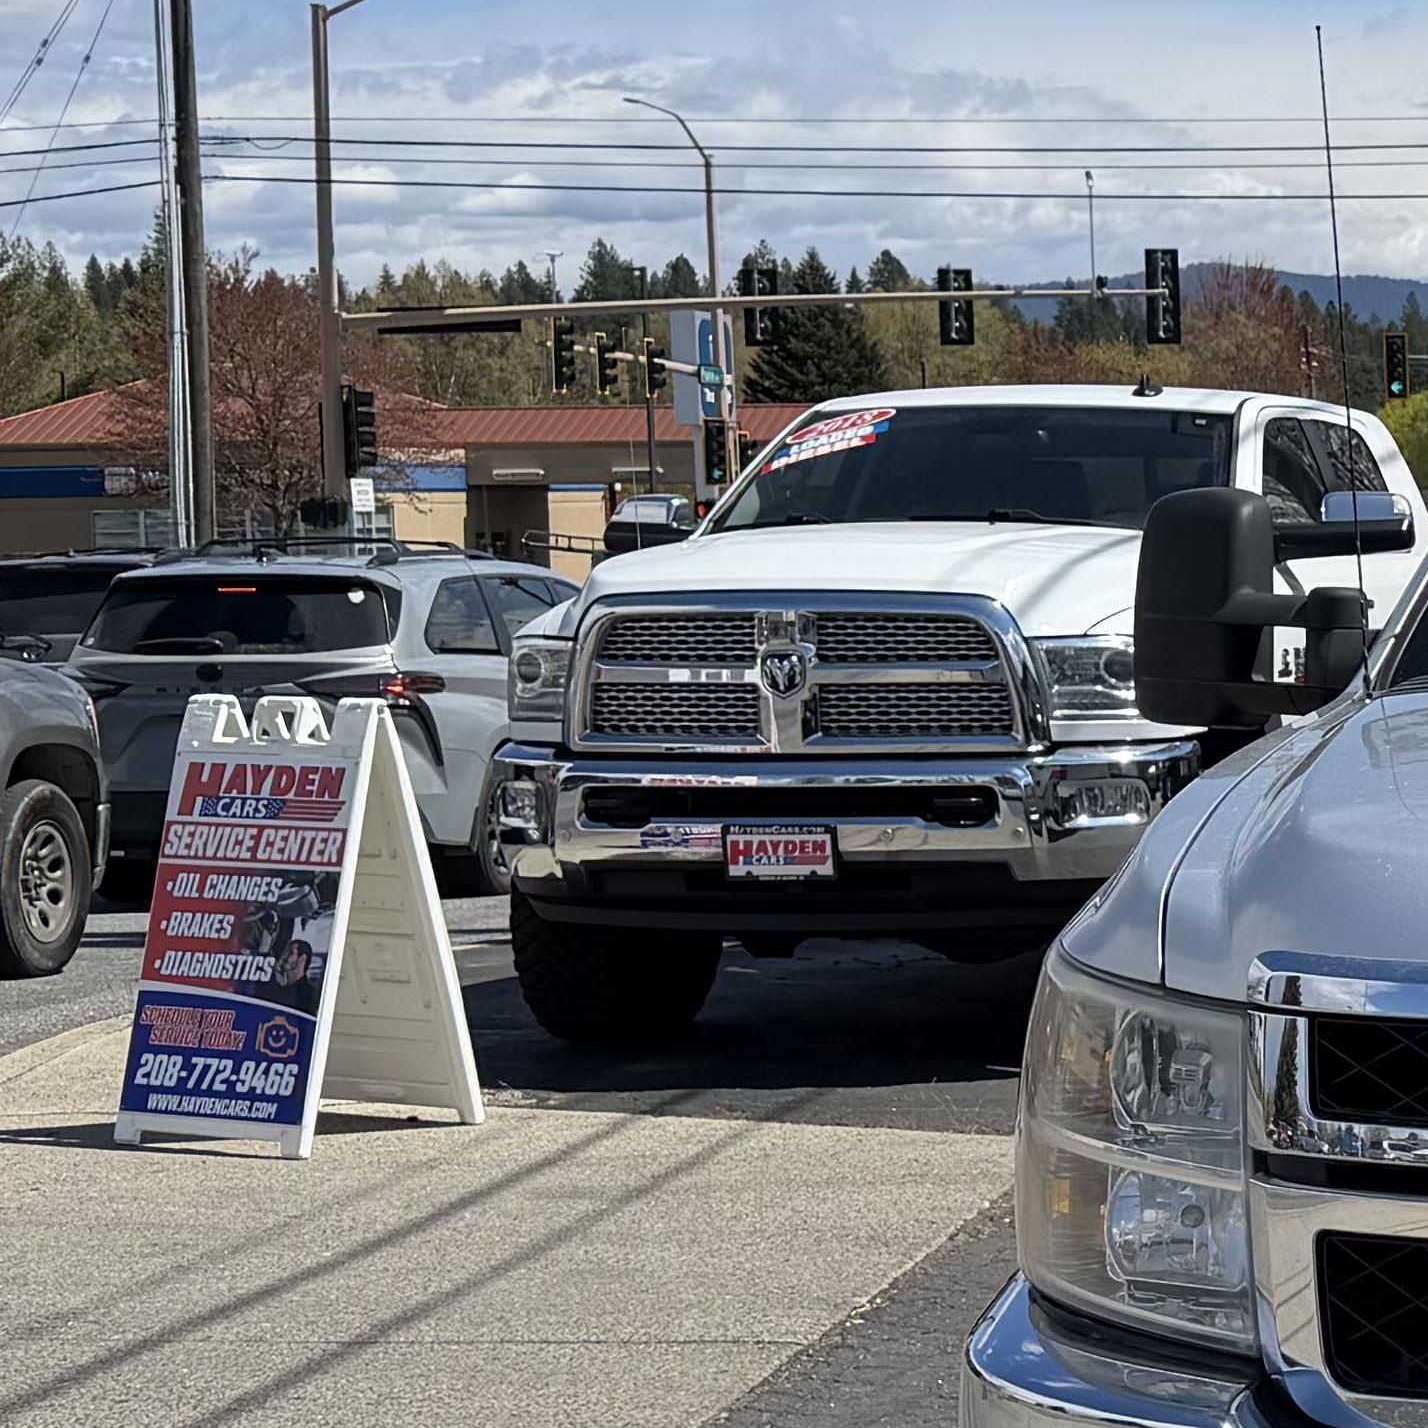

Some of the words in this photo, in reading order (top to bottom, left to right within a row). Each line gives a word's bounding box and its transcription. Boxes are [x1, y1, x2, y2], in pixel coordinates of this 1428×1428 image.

[177, 762, 346, 817] HAYDEN
[216, 798, 269, 818] CARS
[164, 824, 258, 860] SERVICE
[256, 829, 344, 863] CENTER
[729, 840, 827, 865] HAYDEN
[752, 855, 785, 866] CARS
[172, 873, 201, 898] OIL
[203, 874, 283, 902] CHANGES
[166, 912, 234, 939] BRAKES
[160, 951, 275, 982] DIAGNOSTICS
[134, 1053, 299, 1097] 208-772-9466
[147, 1093, 278, 1119] WWW.HAYDENCARS.COM
